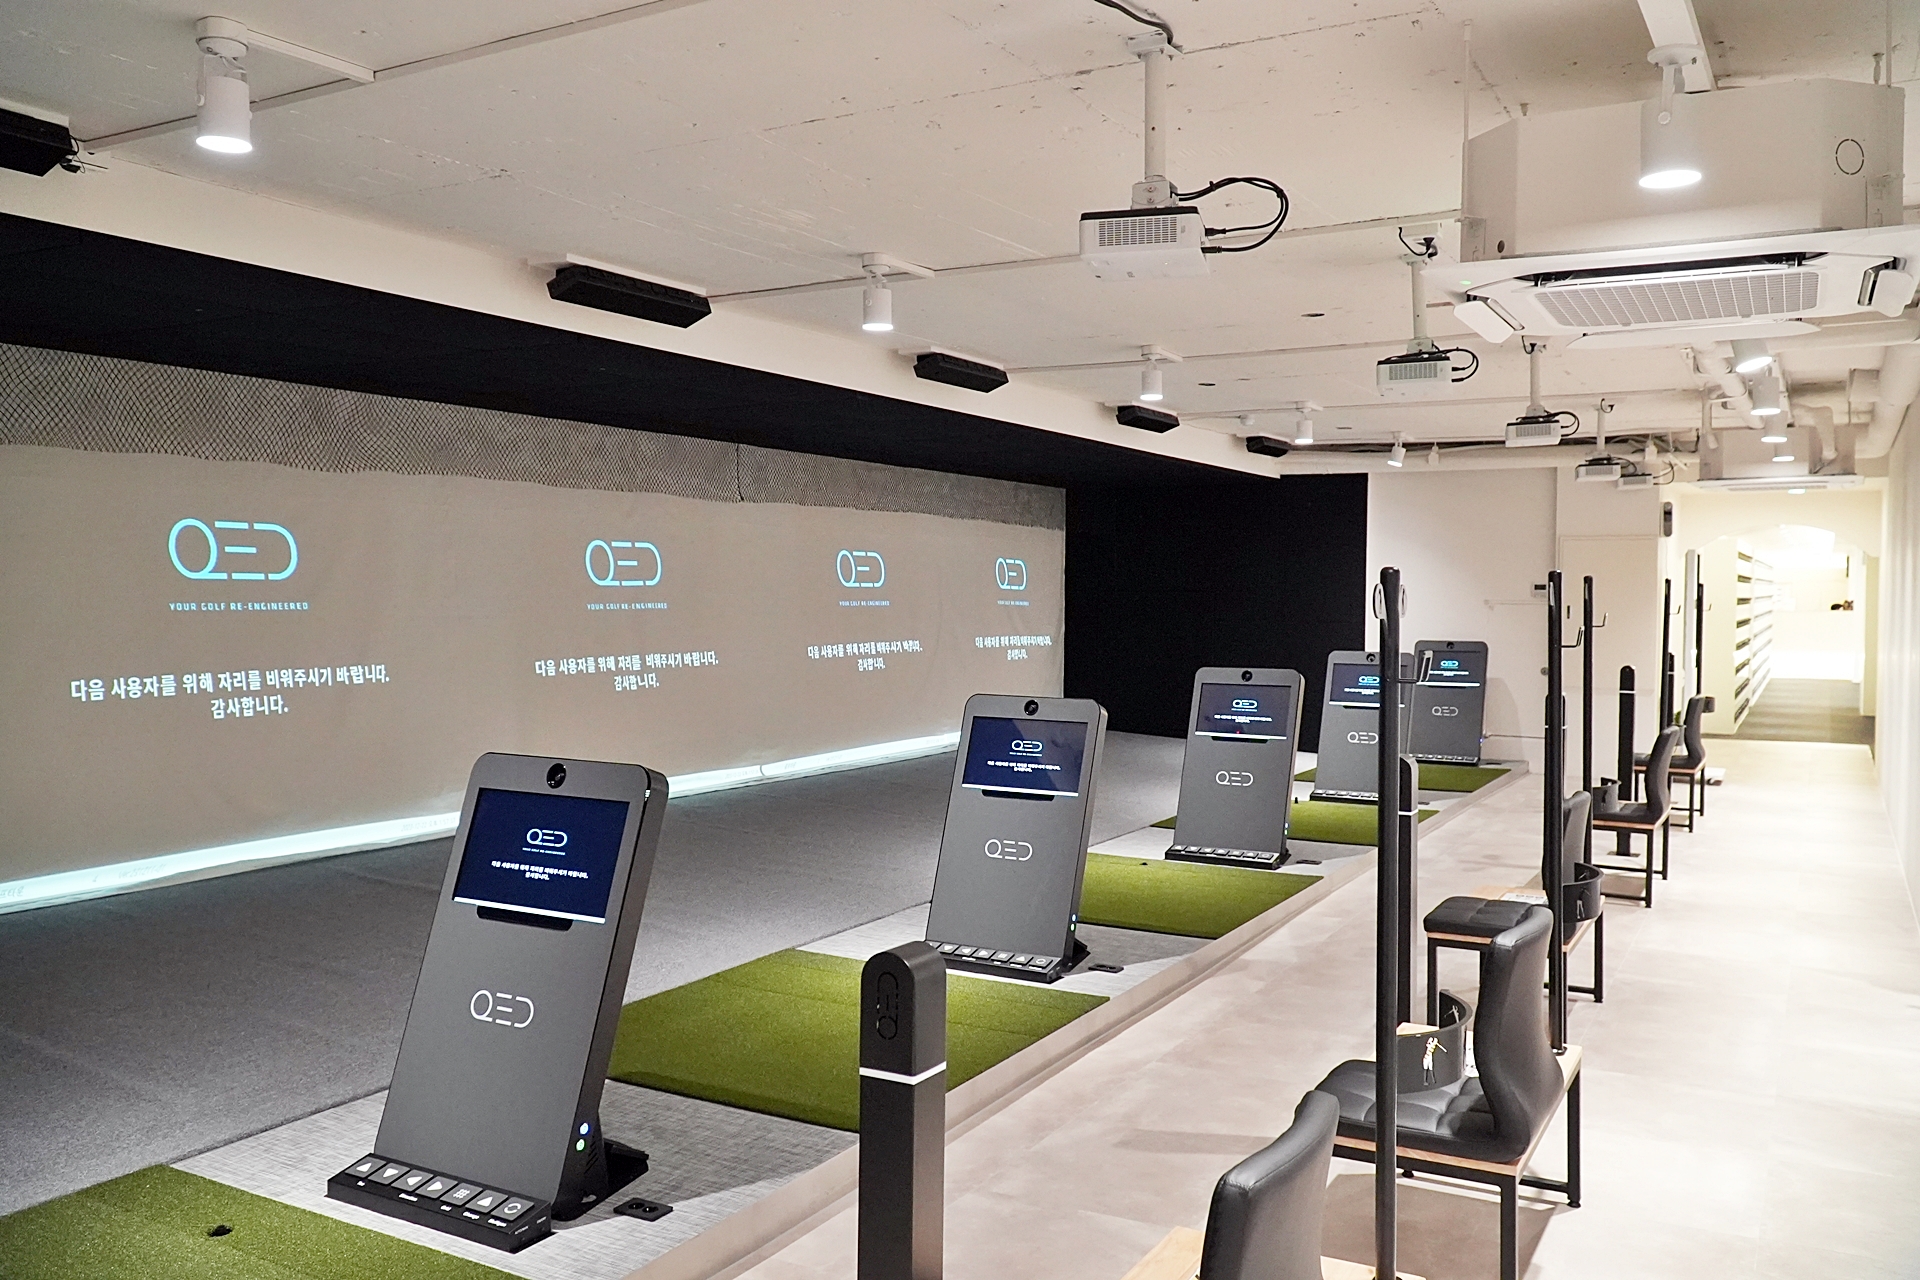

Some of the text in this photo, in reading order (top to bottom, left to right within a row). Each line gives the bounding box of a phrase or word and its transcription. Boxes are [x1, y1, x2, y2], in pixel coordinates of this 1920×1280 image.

[168, 517, 298, 581] QED
[585, 539, 662, 587] QED
[836, 549, 885, 588] QED
[995, 557, 1027, 590] QED
[168, 601, 309, 611] YOUR GOLF RE-ENGINEERED
[586, 602, 604, 610] YOUR
[807, 645, 820, 659] 다음
[821, 644, 844, 658] 사용자를
[846, 643, 859, 656] 위해
[859, 642, 877, 655] 자리를
[535, 650, 719, 677] 다음 사용자를 위해 자리를 비워주시기 바랍니다.
[70, 664, 390, 702] 다음 사용자를 위해 자리를 비워주시기 바랍니다.
[614, 673, 660, 691] 감사합니다.
[211, 694, 289, 719] 감사합니다.
[1432, 706, 1459, 716] QED
[1011, 739, 1043, 752] QED
[1347, 731, 1379, 744] QED
[1215, 769, 1254, 787] QED
[526, 828, 568, 847] QED
[984, 838, 1033, 862] QED
[470, 989, 534, 1028] QED
